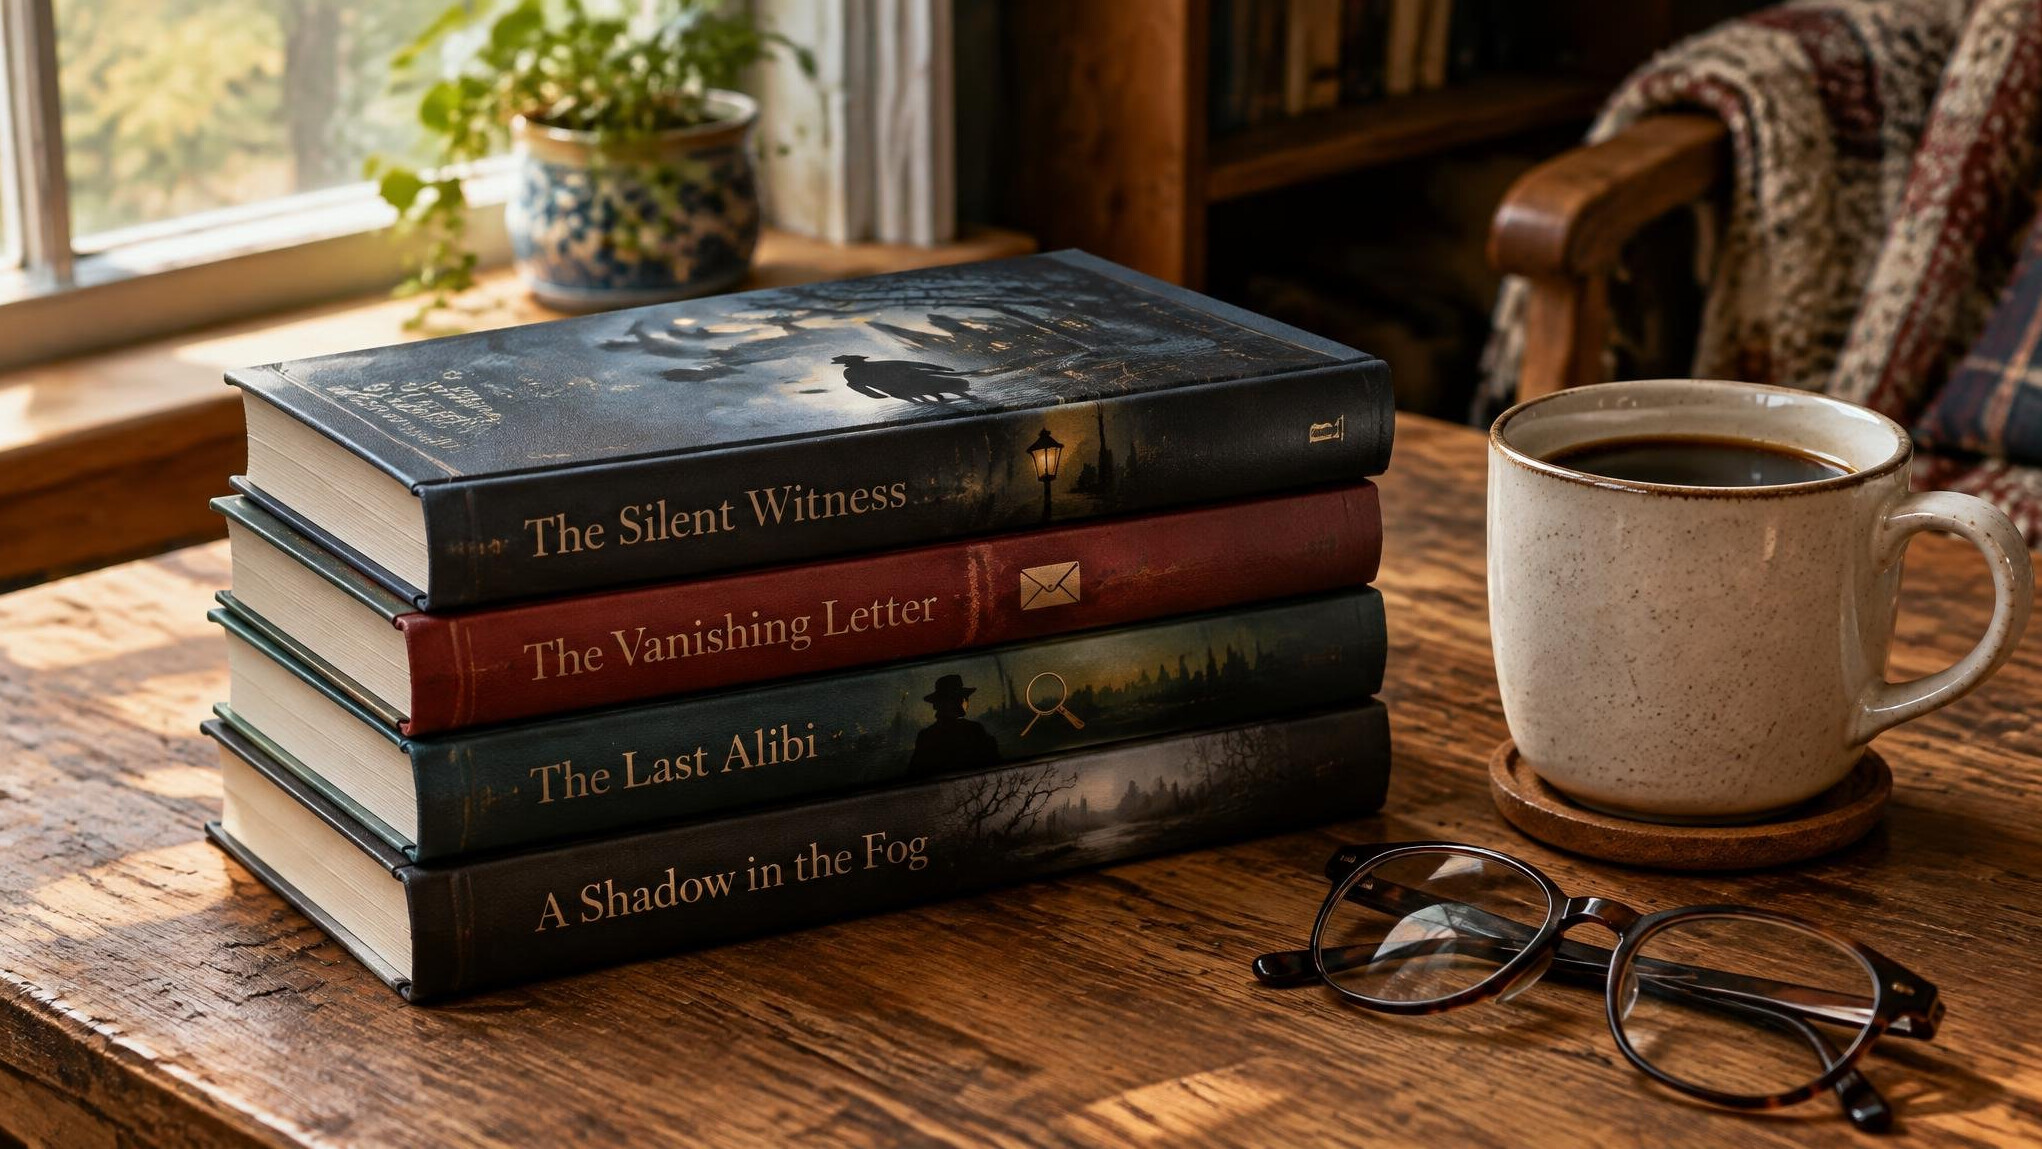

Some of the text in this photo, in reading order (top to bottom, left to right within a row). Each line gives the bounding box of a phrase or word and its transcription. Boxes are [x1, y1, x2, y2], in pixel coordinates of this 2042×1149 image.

[524, 481, 907, 557] The Silent Witness
[523, 595, 938, 681] The Vanishing Letter
[530, 722, 818, 804] The Last Alibi
[534, 831, 930, 933] A Shadow in the Fog
